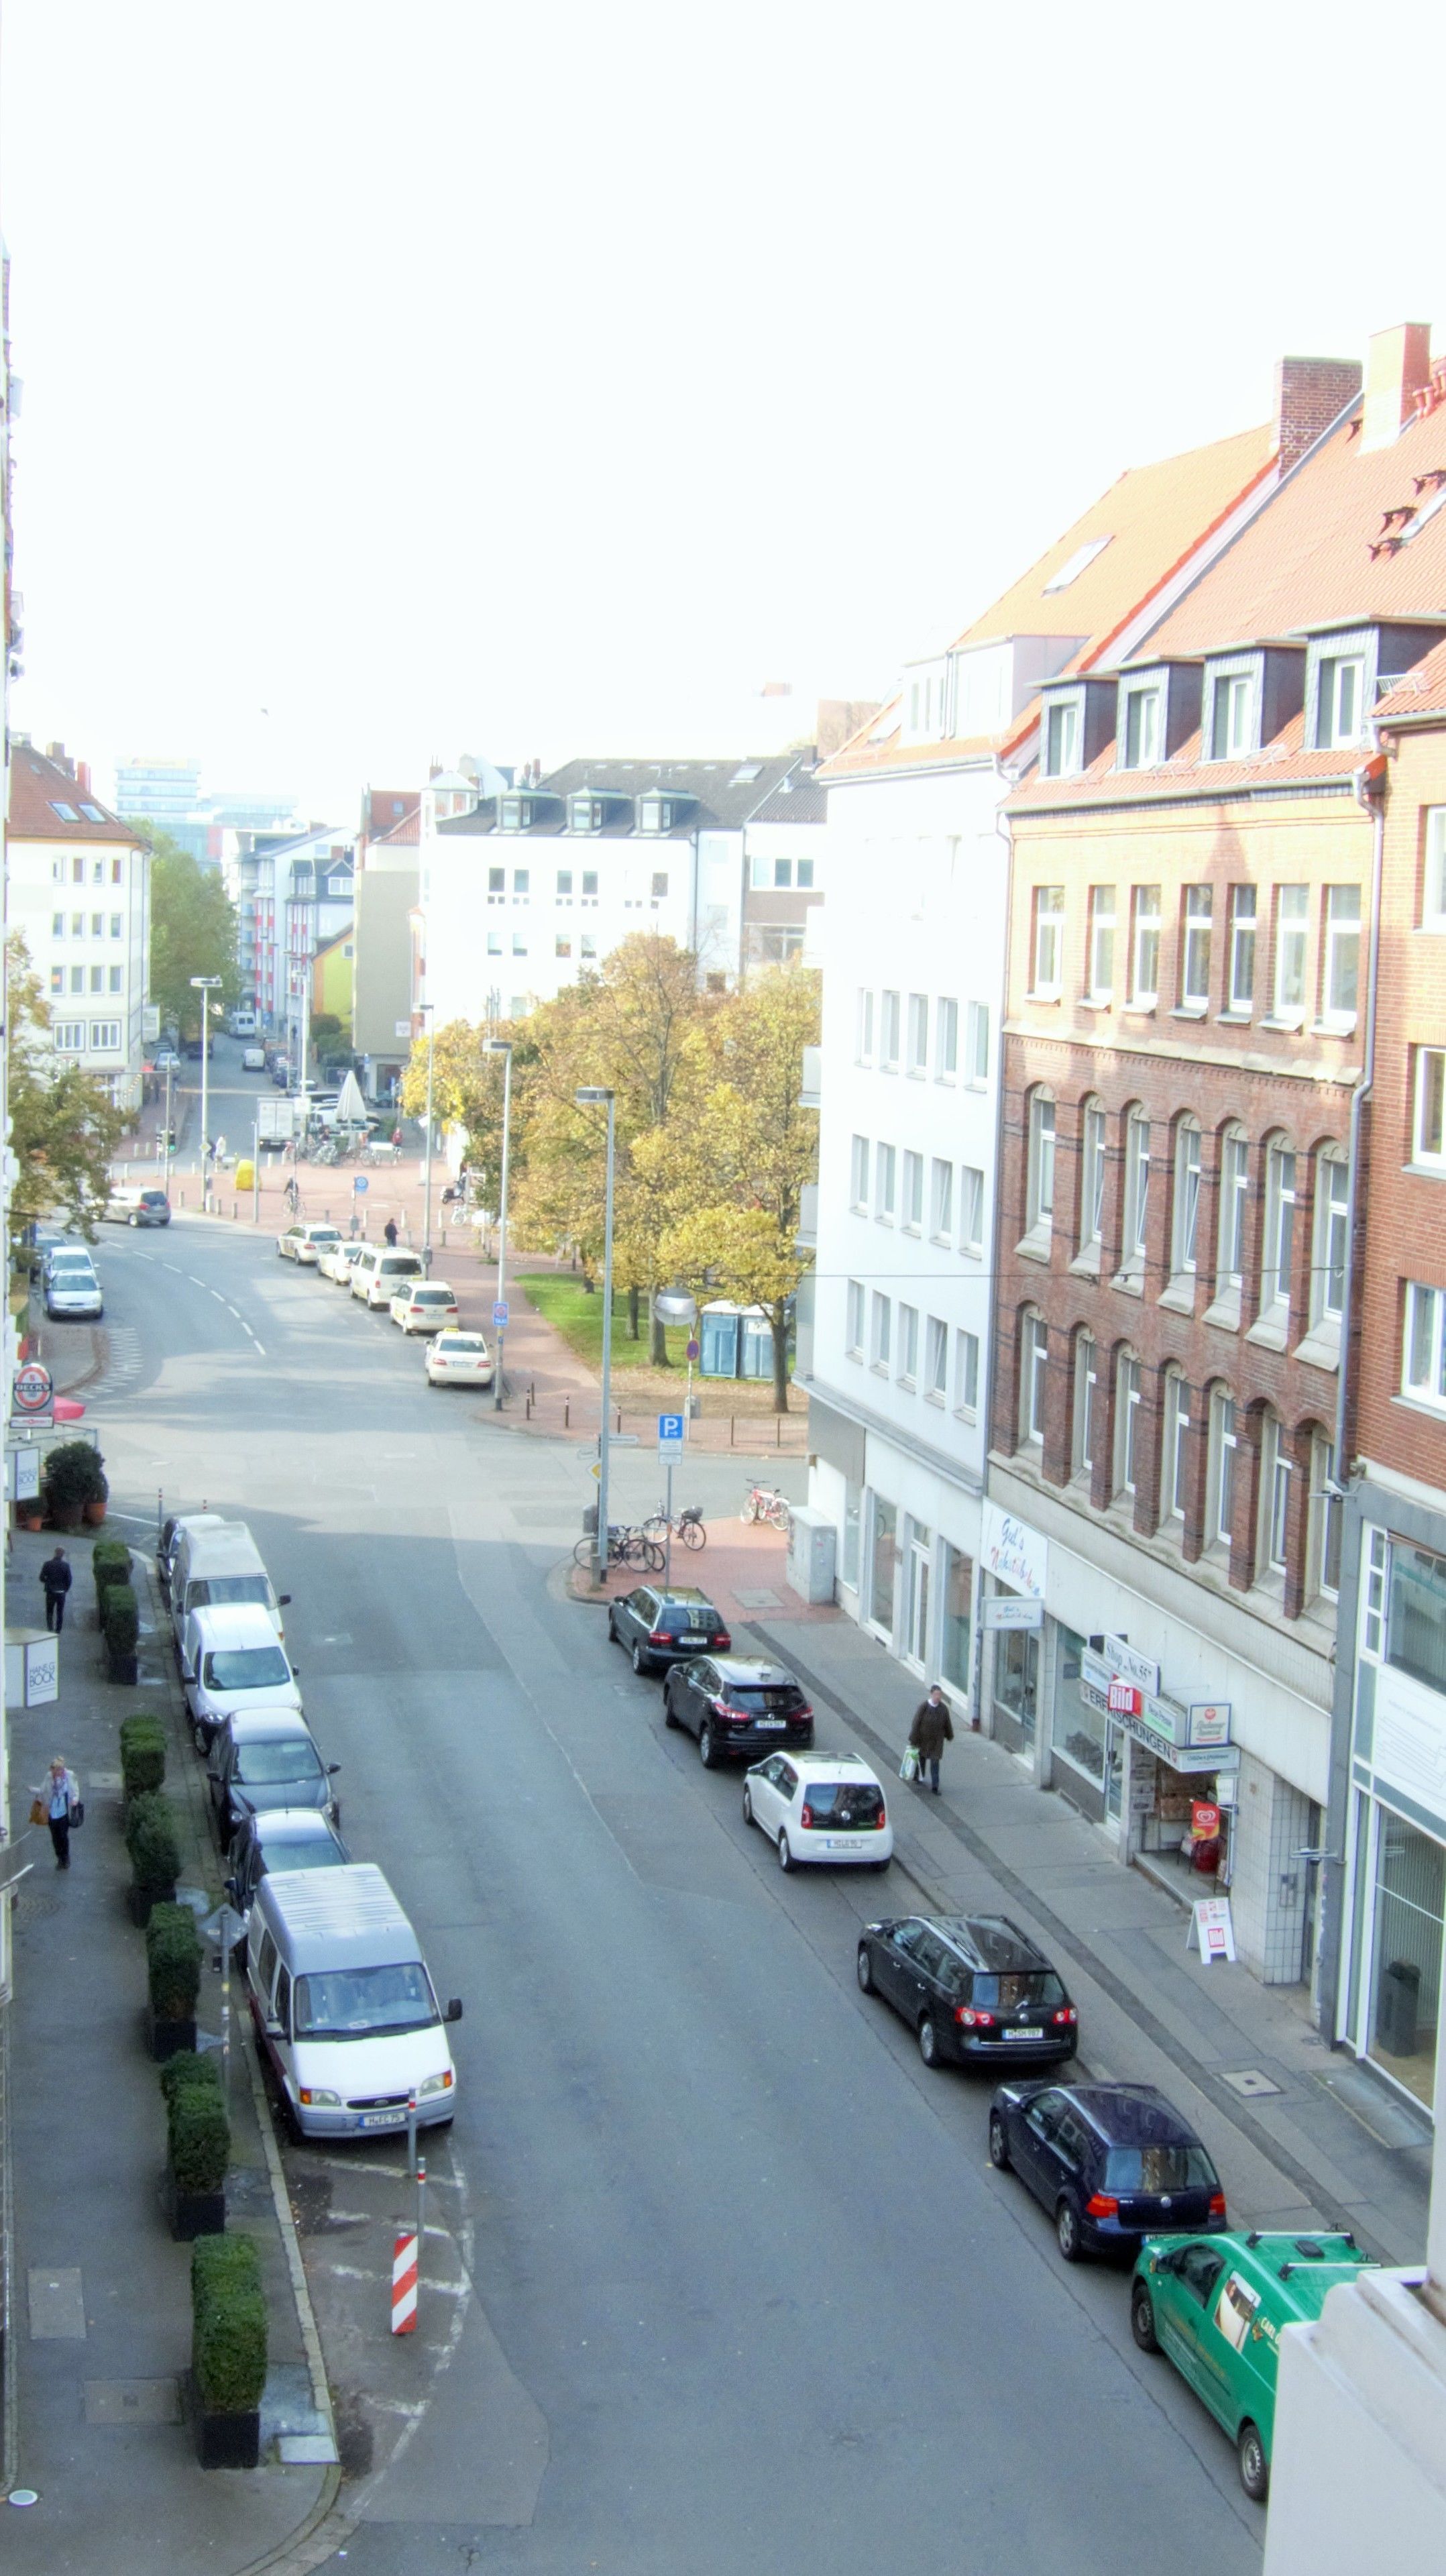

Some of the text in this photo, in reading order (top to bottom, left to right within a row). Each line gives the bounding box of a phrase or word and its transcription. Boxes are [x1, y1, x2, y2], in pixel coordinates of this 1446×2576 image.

[665, 1417, 678, 1436] P
[1107, 1645, 1123, 1668] Shop
[30, 1670, 55, 1687] BOCK
[1110, 1684, 1133, 1711] Bild
